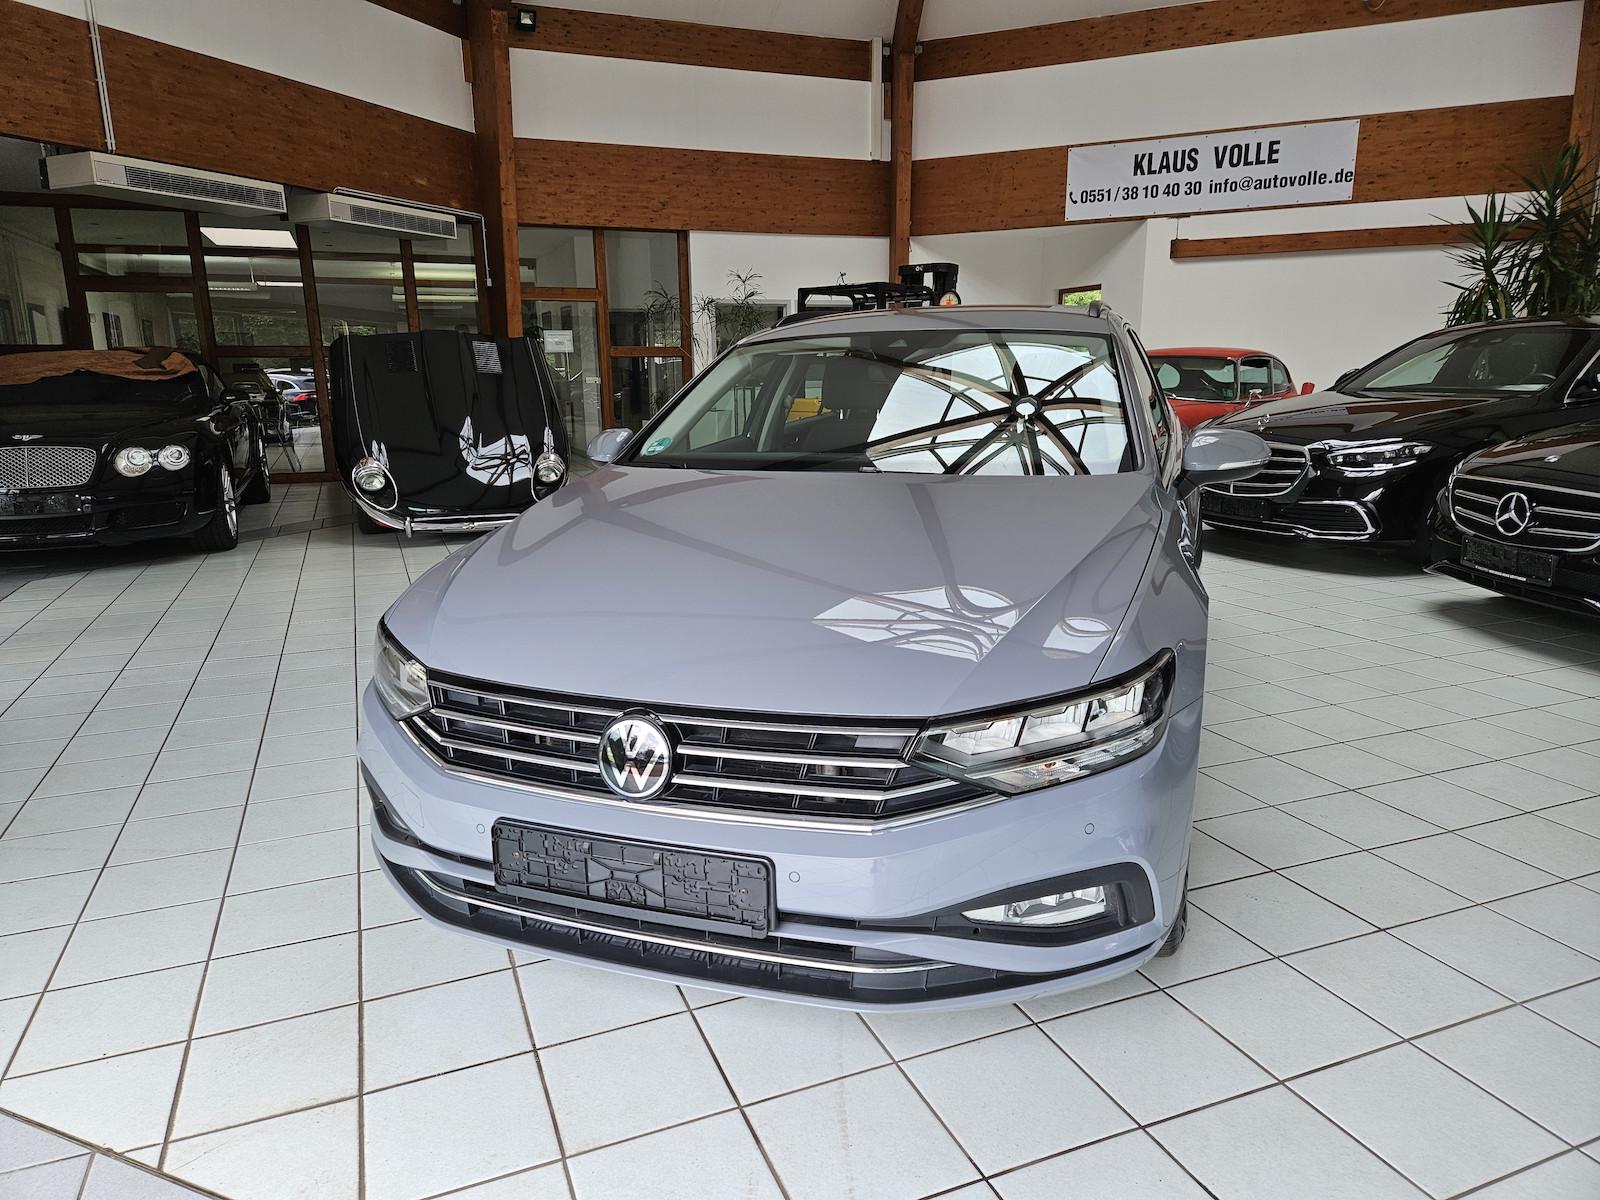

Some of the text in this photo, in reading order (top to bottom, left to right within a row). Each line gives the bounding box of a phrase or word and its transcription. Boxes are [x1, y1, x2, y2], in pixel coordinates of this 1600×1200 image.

[1133, 140, 1281, 177] KLAUS VOLLE
[1143, 184, 1159, 199] 10
[1162, 182, 1180, 197] 40
[1184, 181, 1202, 196] 30
[1209, 168, 1354, 194] info@autovolle.de
[600, 718, 670, 798] VW
